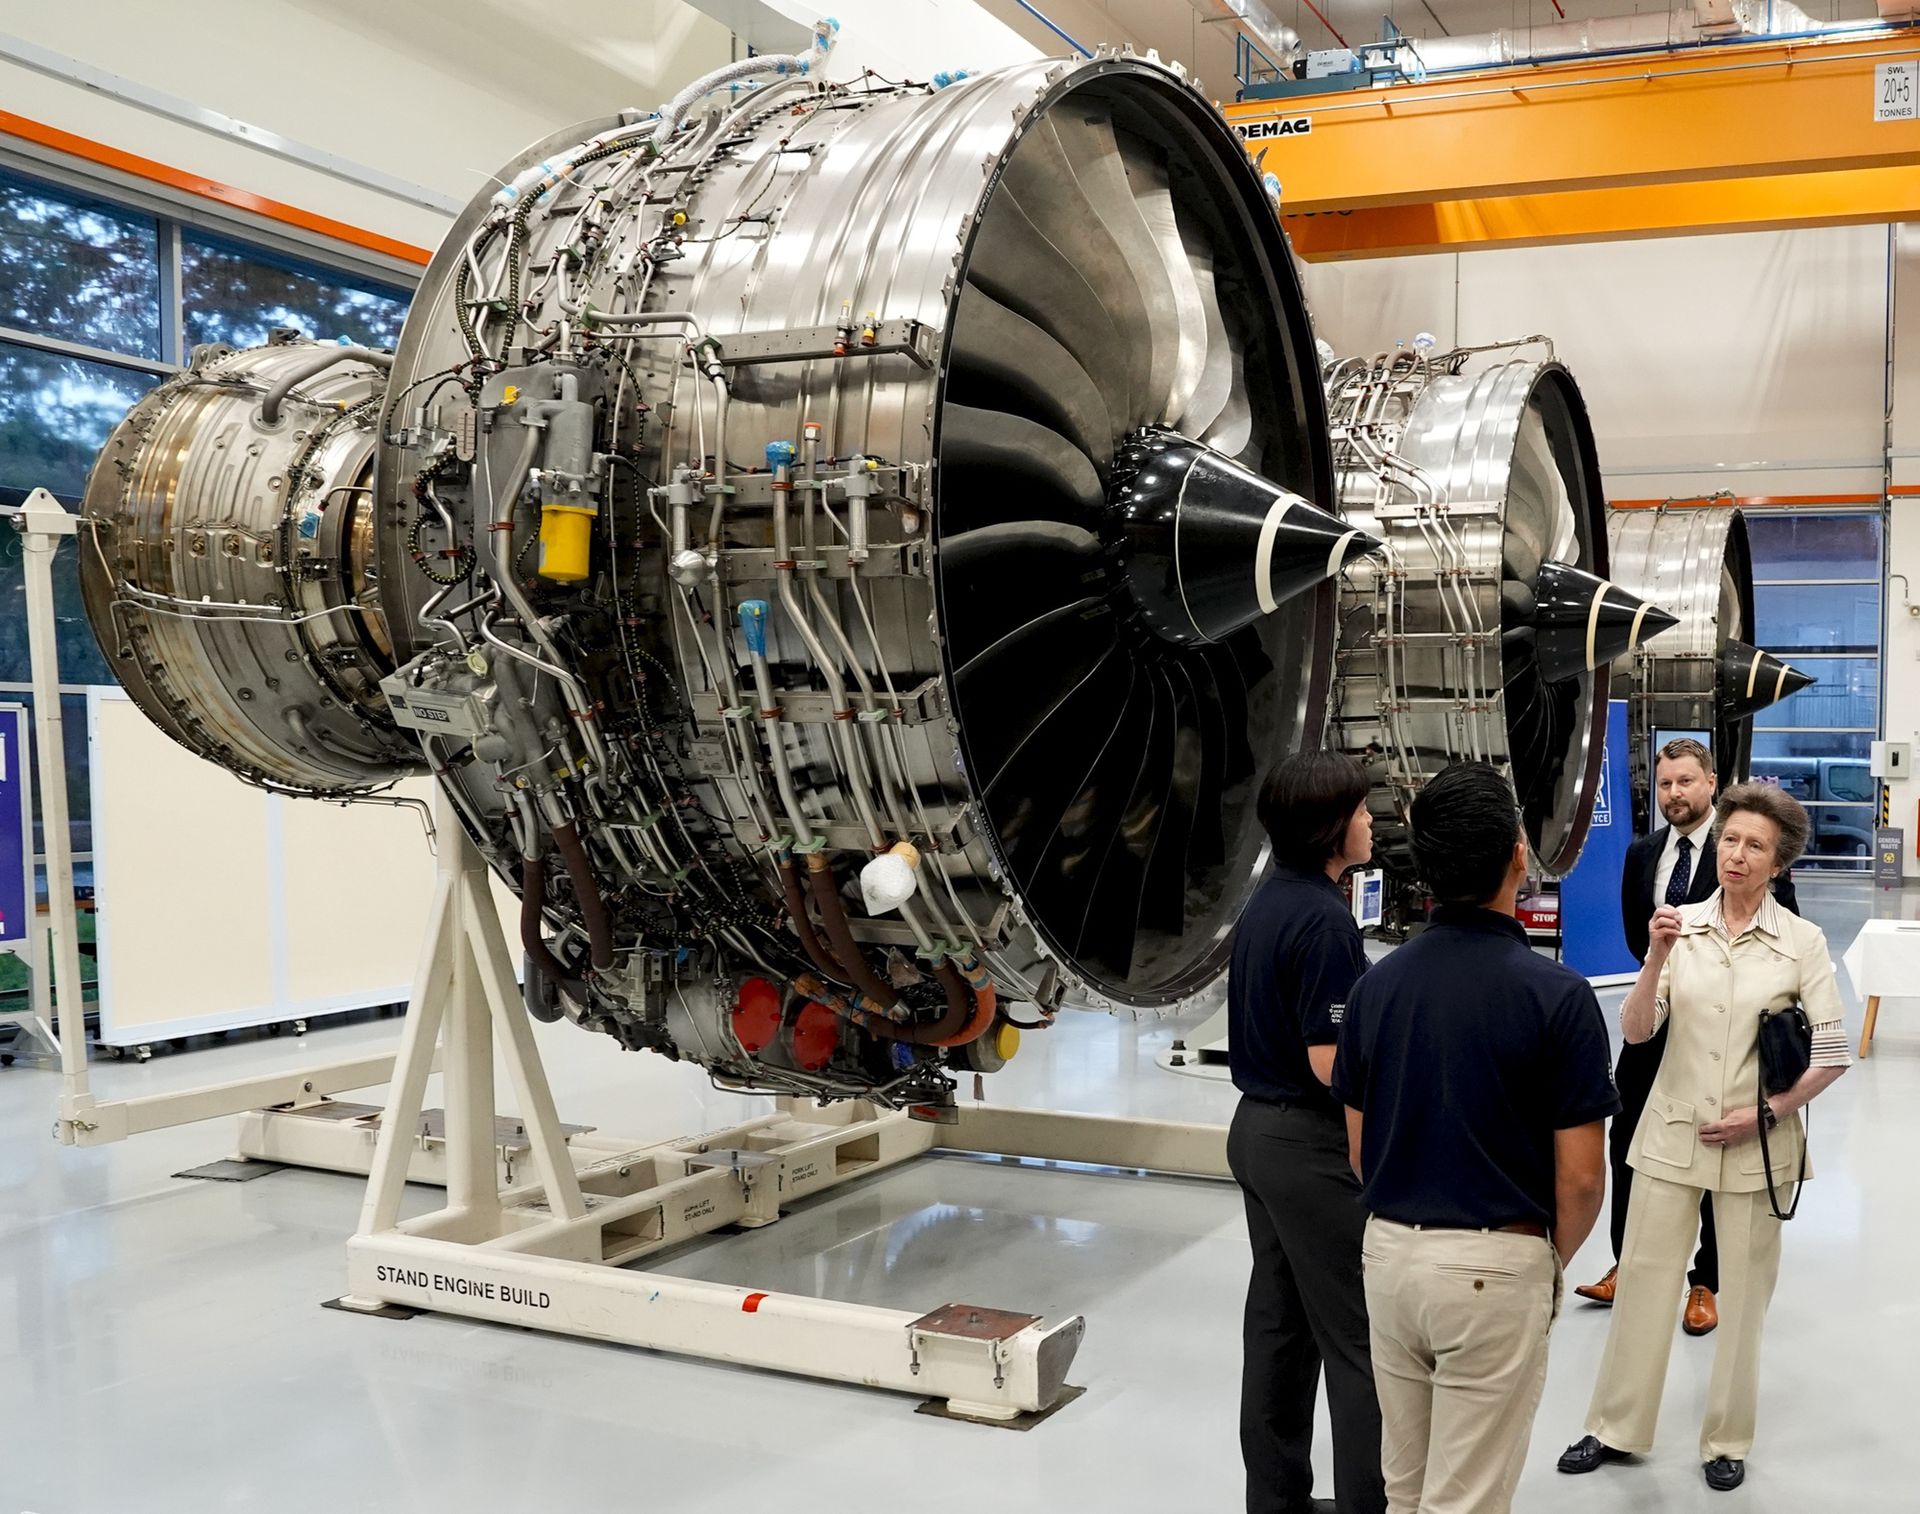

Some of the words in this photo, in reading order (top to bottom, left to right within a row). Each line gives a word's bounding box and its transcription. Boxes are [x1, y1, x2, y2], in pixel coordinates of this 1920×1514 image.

[1887, 66, 1905, 75] SWL
[1884, 77, 1910, 103] 20+5
[1879, 107, 1912, 117] TONNES
[1232, 119, 1310, 138] DEMAG
[413, 707, 427, 718] NO
[426, 709, 448, 721] STEP
[1593, 814, 1608, 823] YCE
[1532, 913, 1557, 922] STOP
[376, 1265, 429, 1288] STAND
[434, 1274, 495, 1300] ENGINE
[500, 1285, 550, 1309] BUILD
